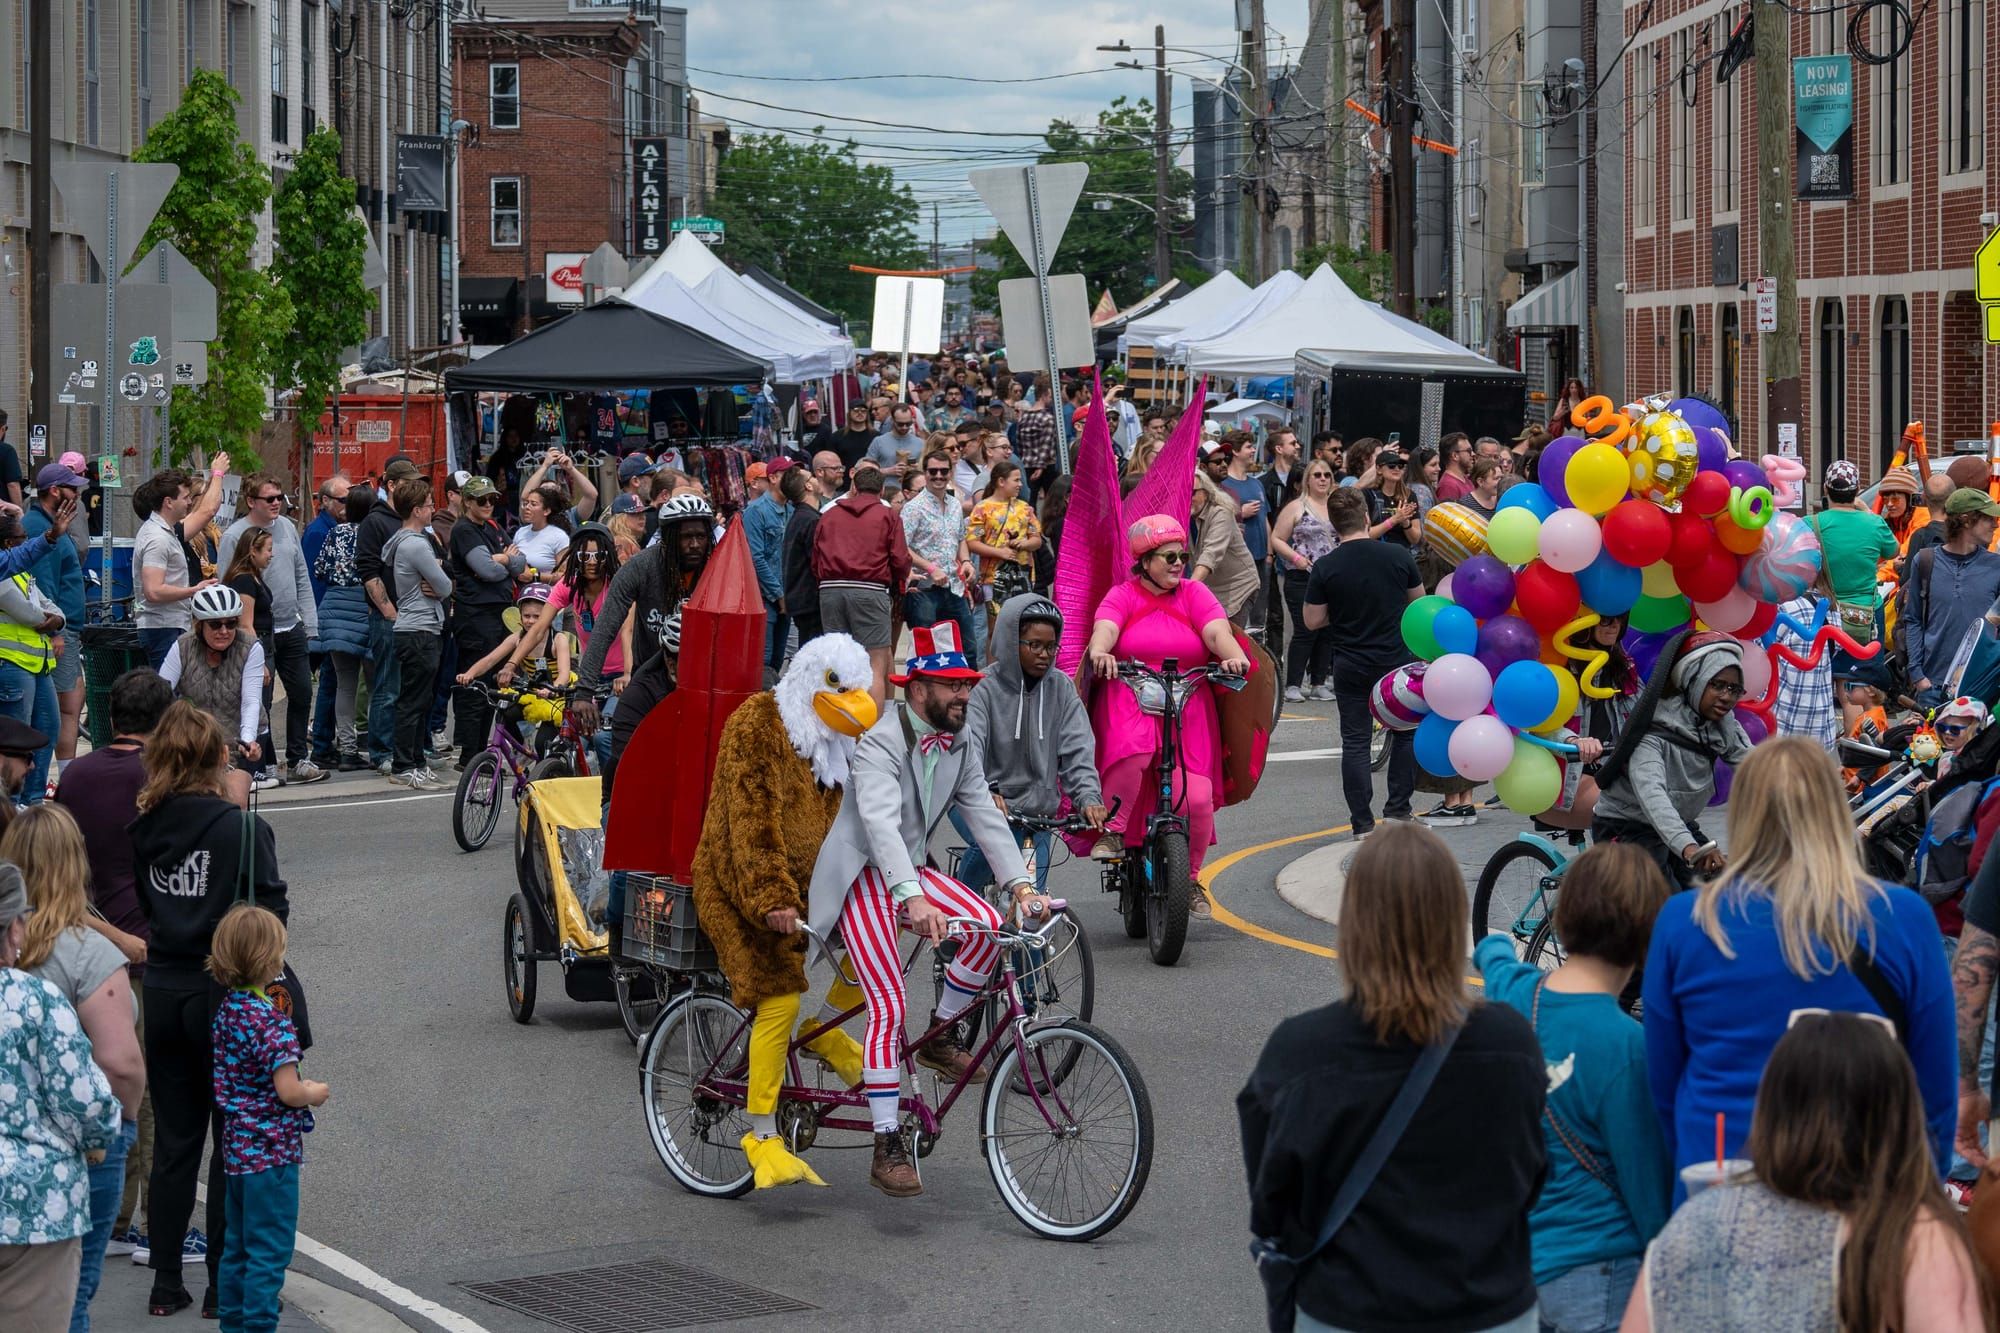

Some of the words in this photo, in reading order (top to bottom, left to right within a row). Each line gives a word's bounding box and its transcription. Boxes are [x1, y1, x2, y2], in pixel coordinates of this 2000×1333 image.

[1807, 65, 1839, 80] NOW
[1799, 82, 1848, 98] LEASING!
[398, 140, 442, 150] Frankford
[641, 144, 660, 250] ATLANTIS
[680, 222, 711, 230] Hagert
[1760, 296, 1772, 304] ANY
[1760, 306, 1773, 314] TIME
[82, 360, 98, 369] 10
[597, 407, 615, 431] 34
[199, 850, 211, 897] philadelphia
